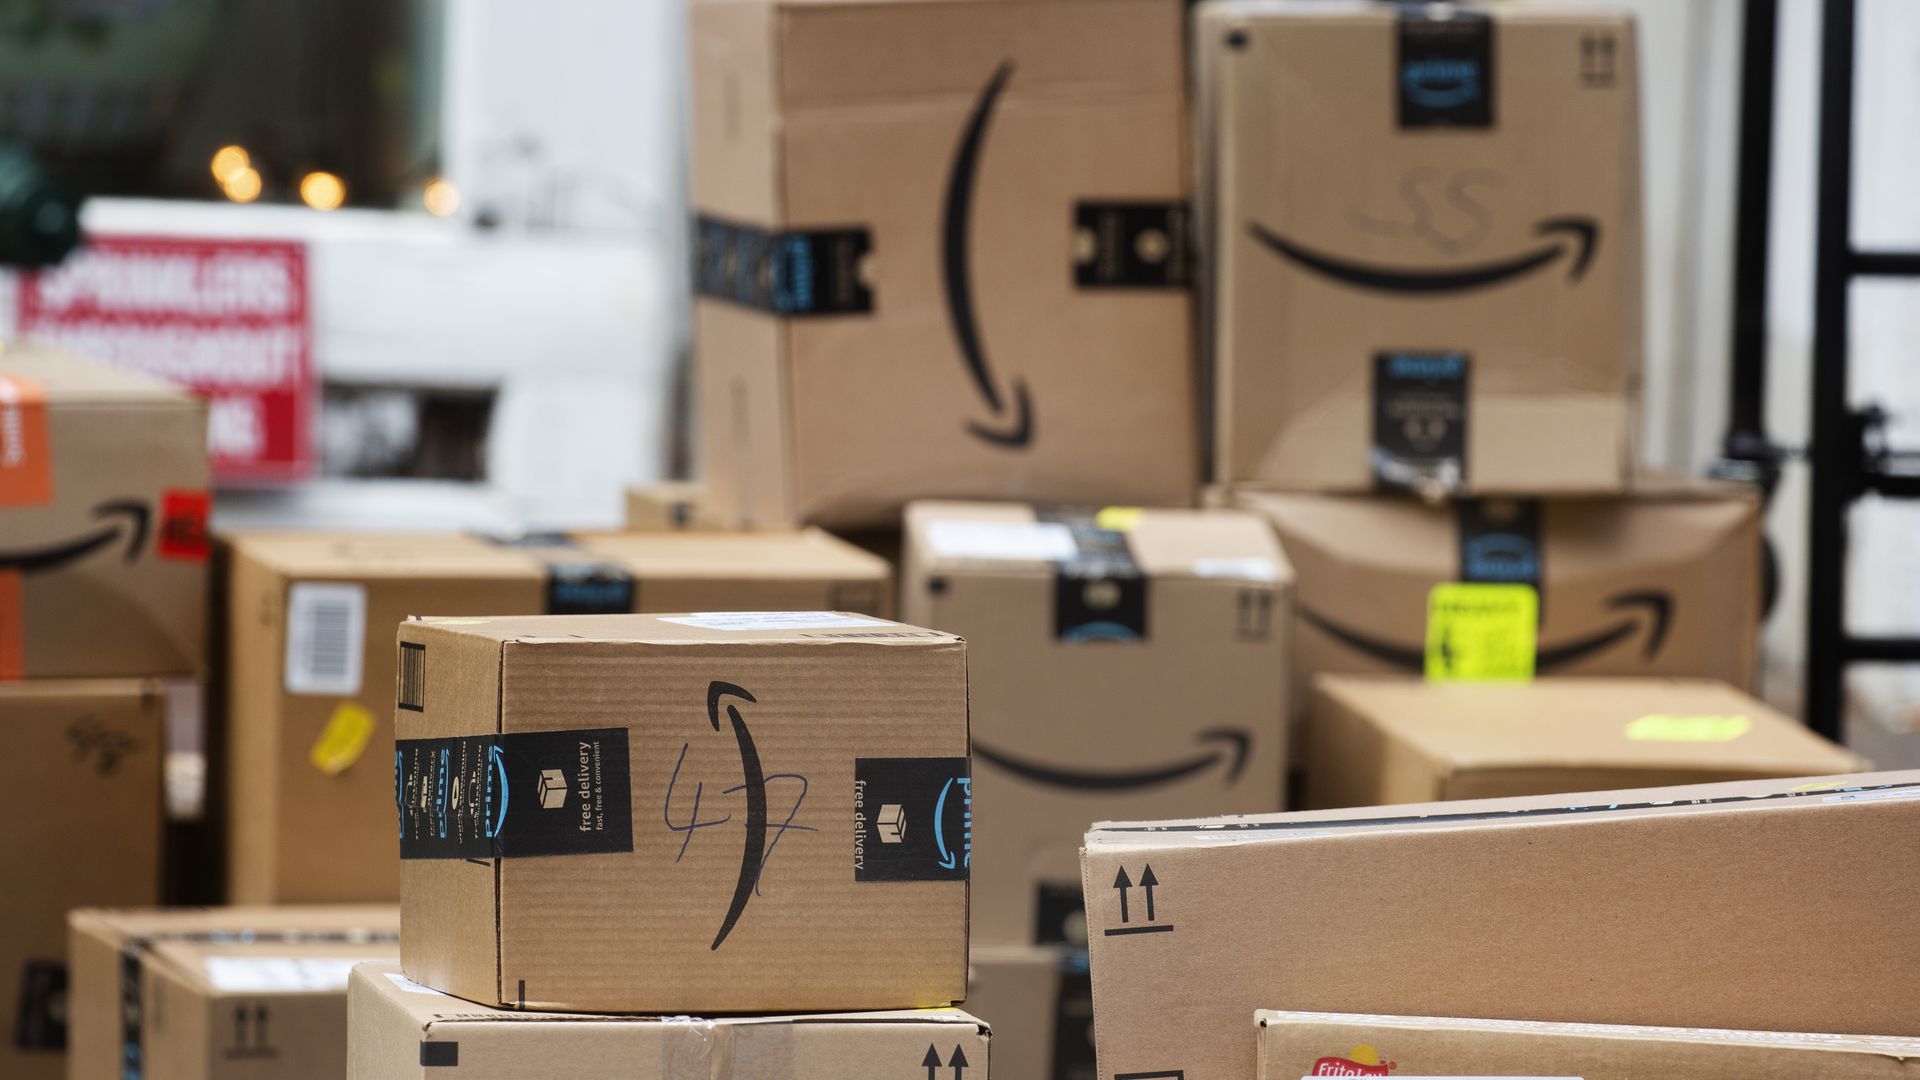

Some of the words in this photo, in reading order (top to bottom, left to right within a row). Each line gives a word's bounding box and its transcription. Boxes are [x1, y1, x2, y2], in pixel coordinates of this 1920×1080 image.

[577, 741, 591, 799] delivery
[592, 740, 602, 785] convenient
[484, 745, 493, 838] prime
[594, 786, 602, 794] &
[594, 795, 603, 812] free
[854, 779, 867, 808] free
[579, 803, 592, 832] free
[595, 812, 604, 831] fast,
[663, 742, 819, 897] 47
[854, 812, 867, 870] delivery
